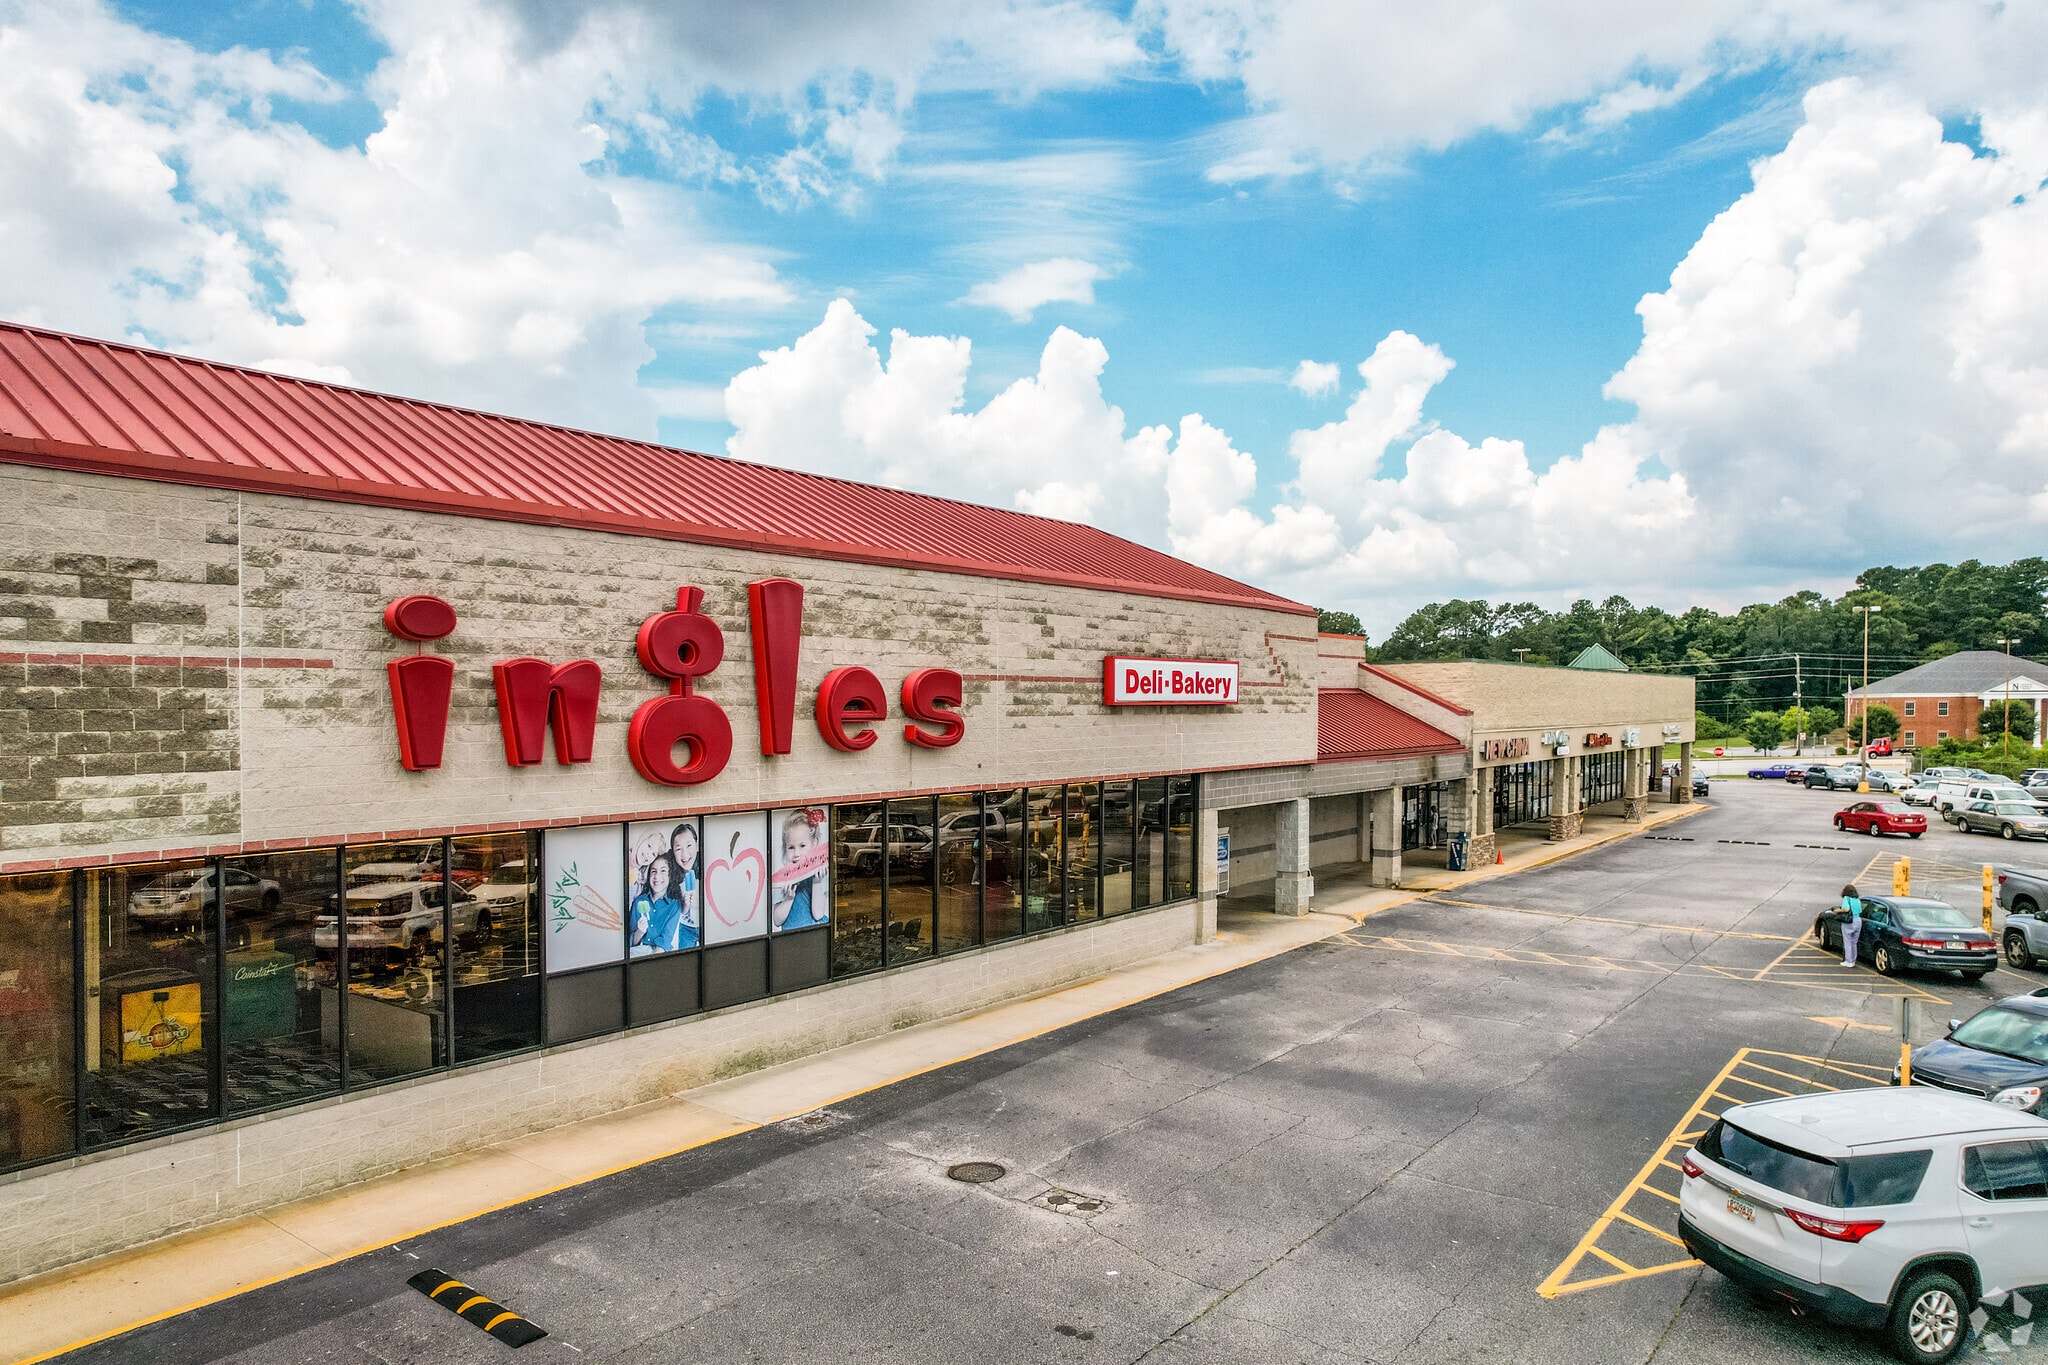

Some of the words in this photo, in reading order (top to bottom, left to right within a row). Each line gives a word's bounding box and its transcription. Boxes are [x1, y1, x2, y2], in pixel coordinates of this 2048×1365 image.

[383, 577, 965, 787] ingles
[1485, 740, 1506, 760] NEW
[1507, 737, 1530, 758] CHINA
